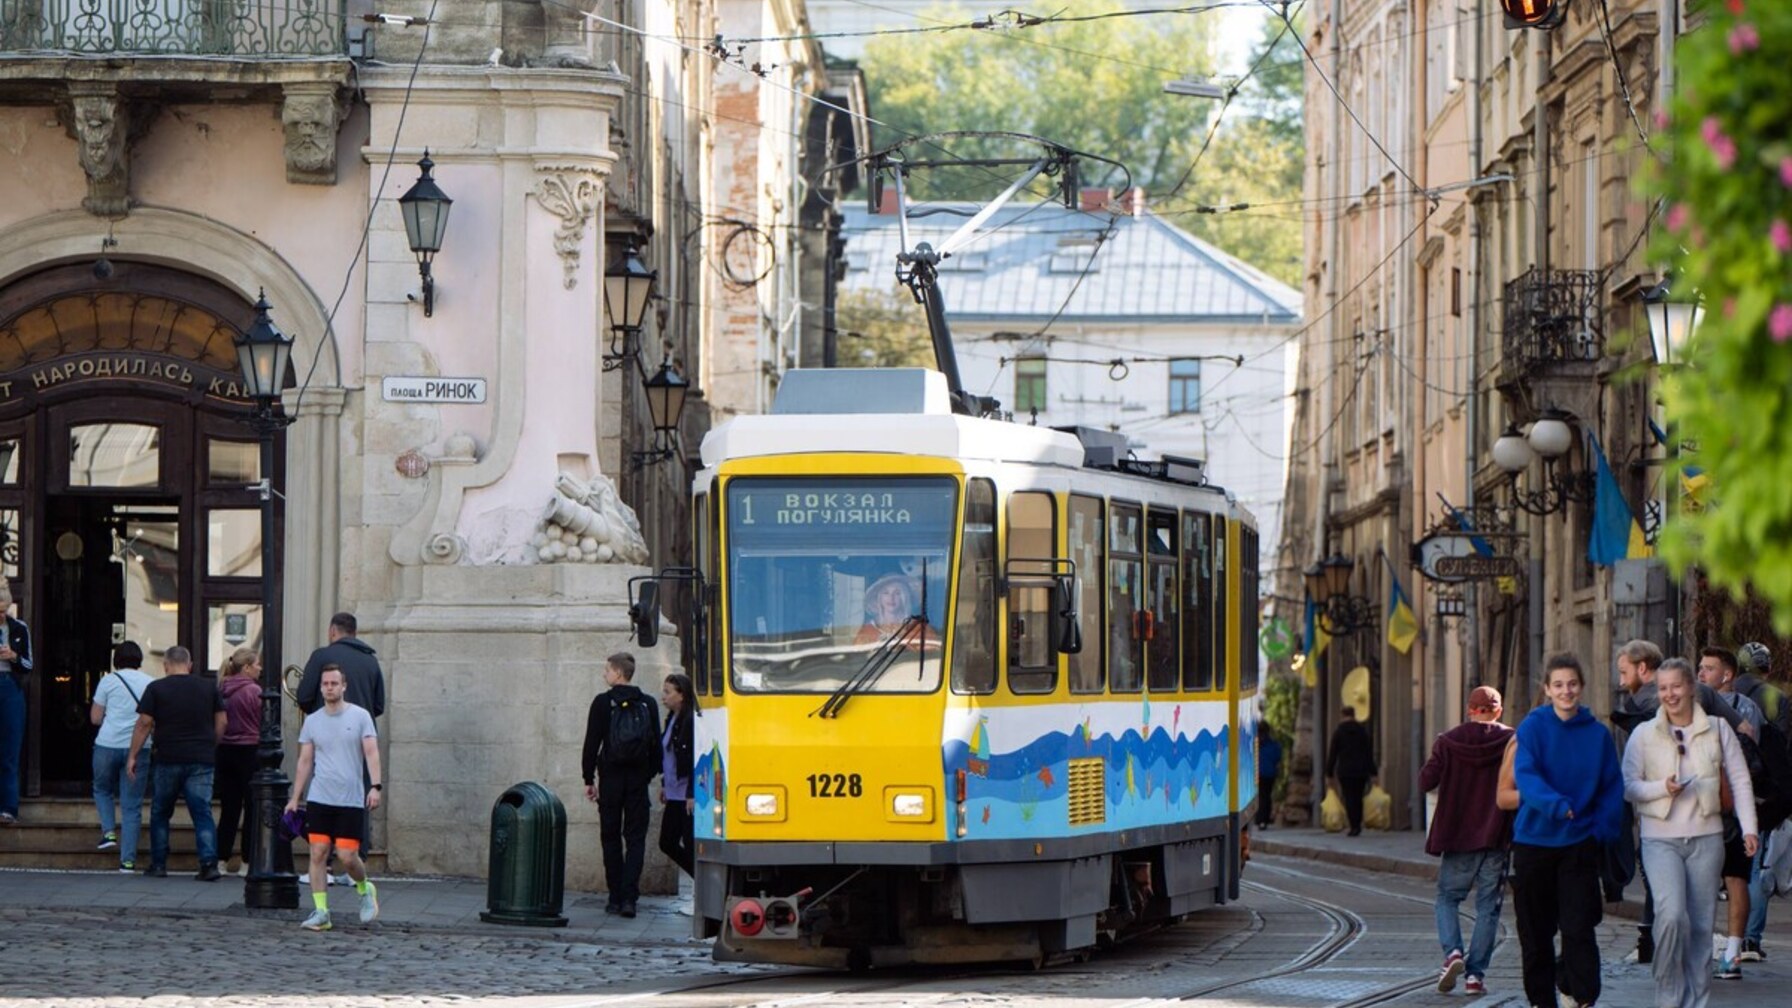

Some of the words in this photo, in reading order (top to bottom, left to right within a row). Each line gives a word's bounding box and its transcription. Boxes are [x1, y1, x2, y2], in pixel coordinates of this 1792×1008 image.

[31, 358, 193, 388] НАРОДИЛАСЬ
[425, 381, 477, 399] РИНОК
[742, 494, 755, 524] 1
[785, 493, 893, 508] ВОКЗАЛ
[777, 509, 911, 524] ПОГУЛЯНКА
[806, 773, 863, 798] 1228
